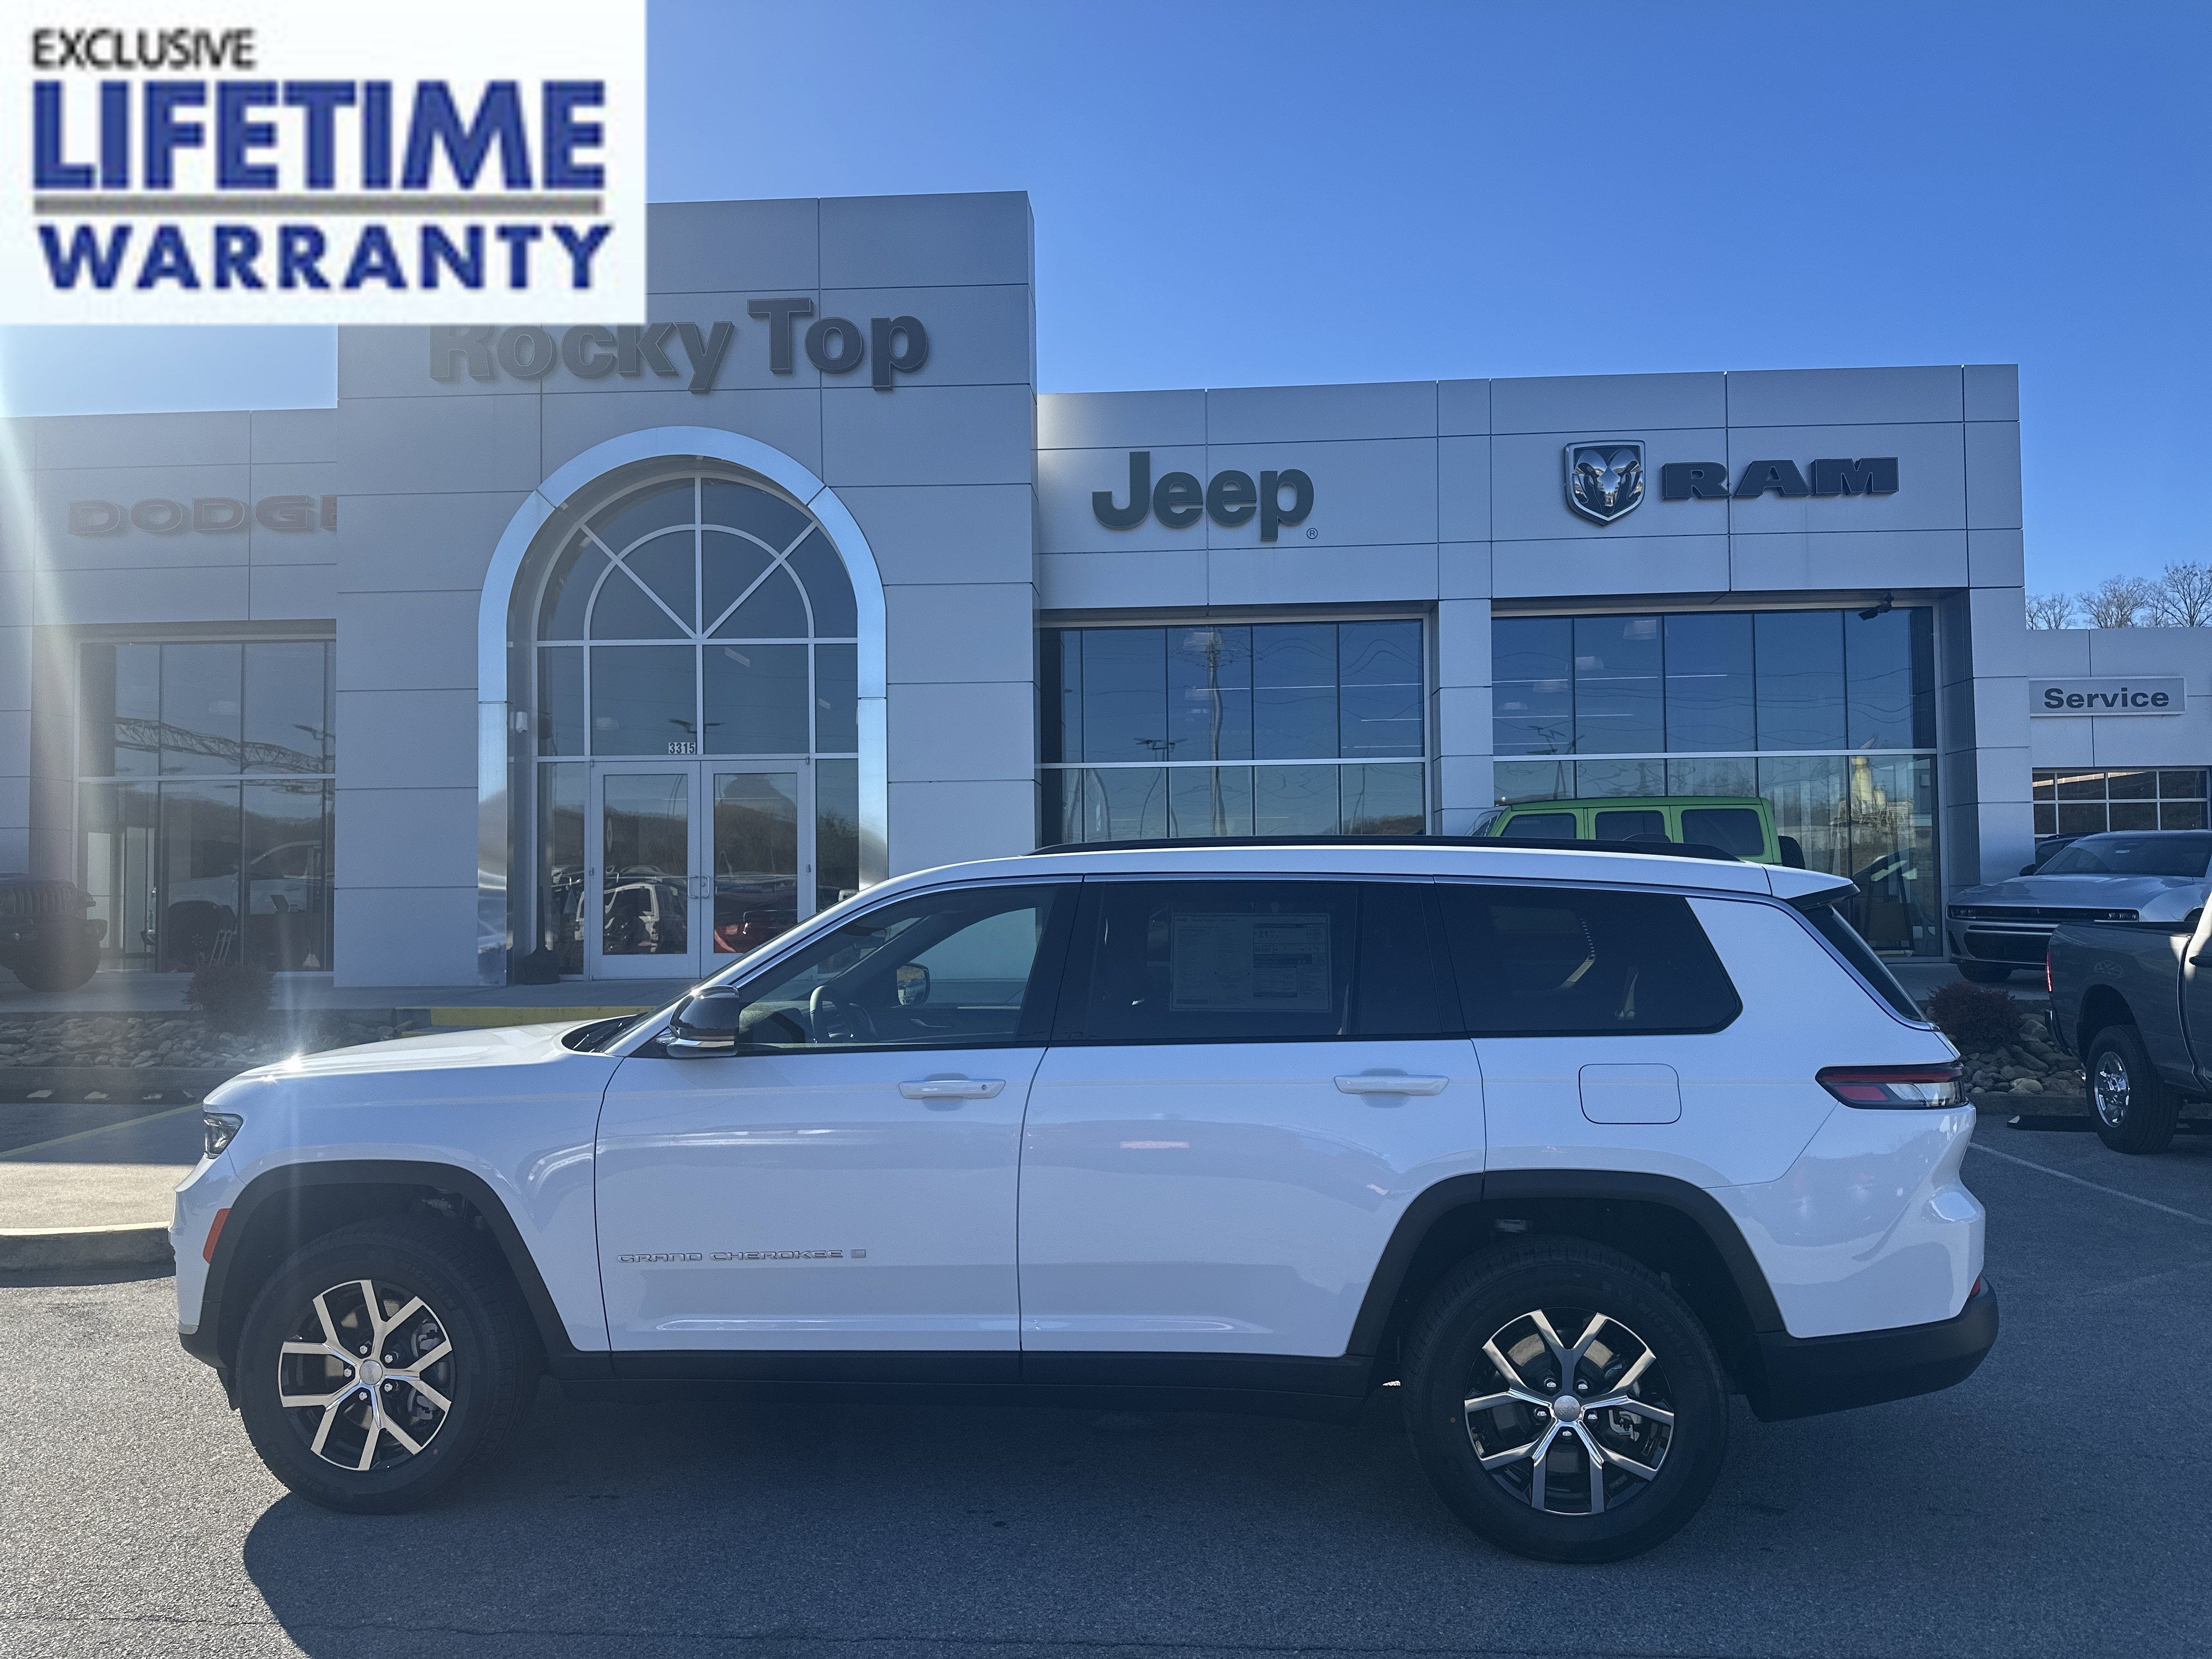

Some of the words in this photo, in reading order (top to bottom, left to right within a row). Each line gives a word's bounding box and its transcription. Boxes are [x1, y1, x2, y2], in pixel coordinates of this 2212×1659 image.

[747, 297, 929, 391] Top
[1662, 456, 1899, 500] RAM
[1092, 451, 1314, 541] Jeep
[2044, 687, 2170, 709] Service
[669, 742, 695, 754] 3315
[617, 1252, 702, 1262] GRAND
[709, 1250, 844, 1261] CHEROKEE
